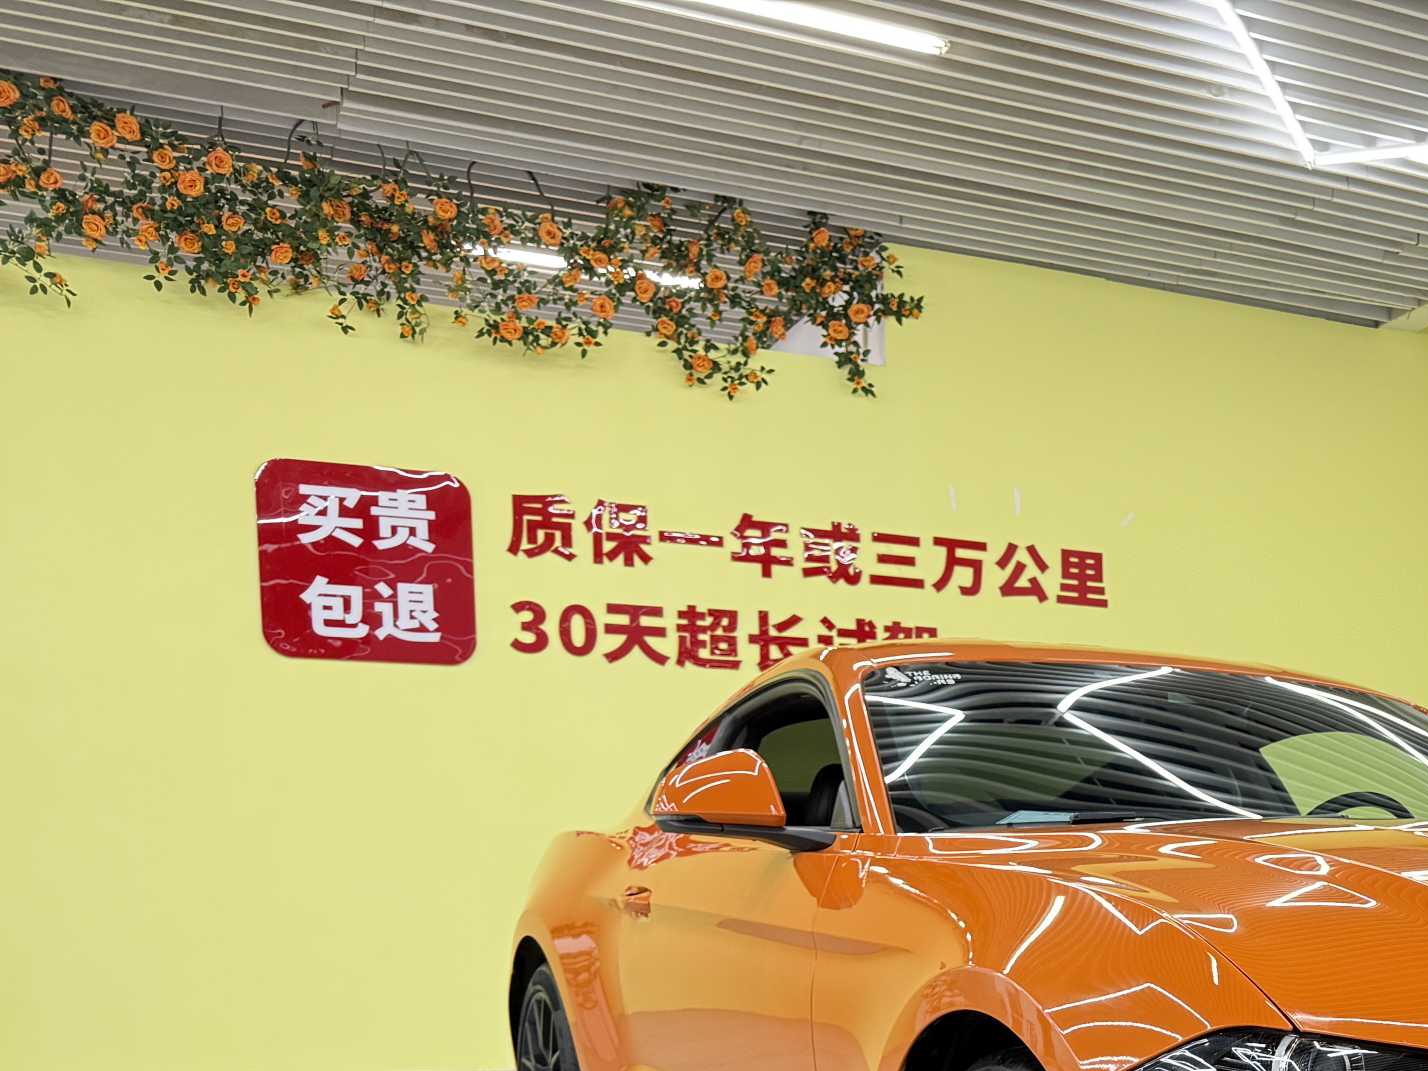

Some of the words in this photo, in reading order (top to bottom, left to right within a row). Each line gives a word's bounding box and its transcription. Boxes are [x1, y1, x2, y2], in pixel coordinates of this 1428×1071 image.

[297, 484, 436, 553] 买贵
[507, 494, 1109, 608] 质保一年或三万公里
[299, 575, 441, 643] 包退
